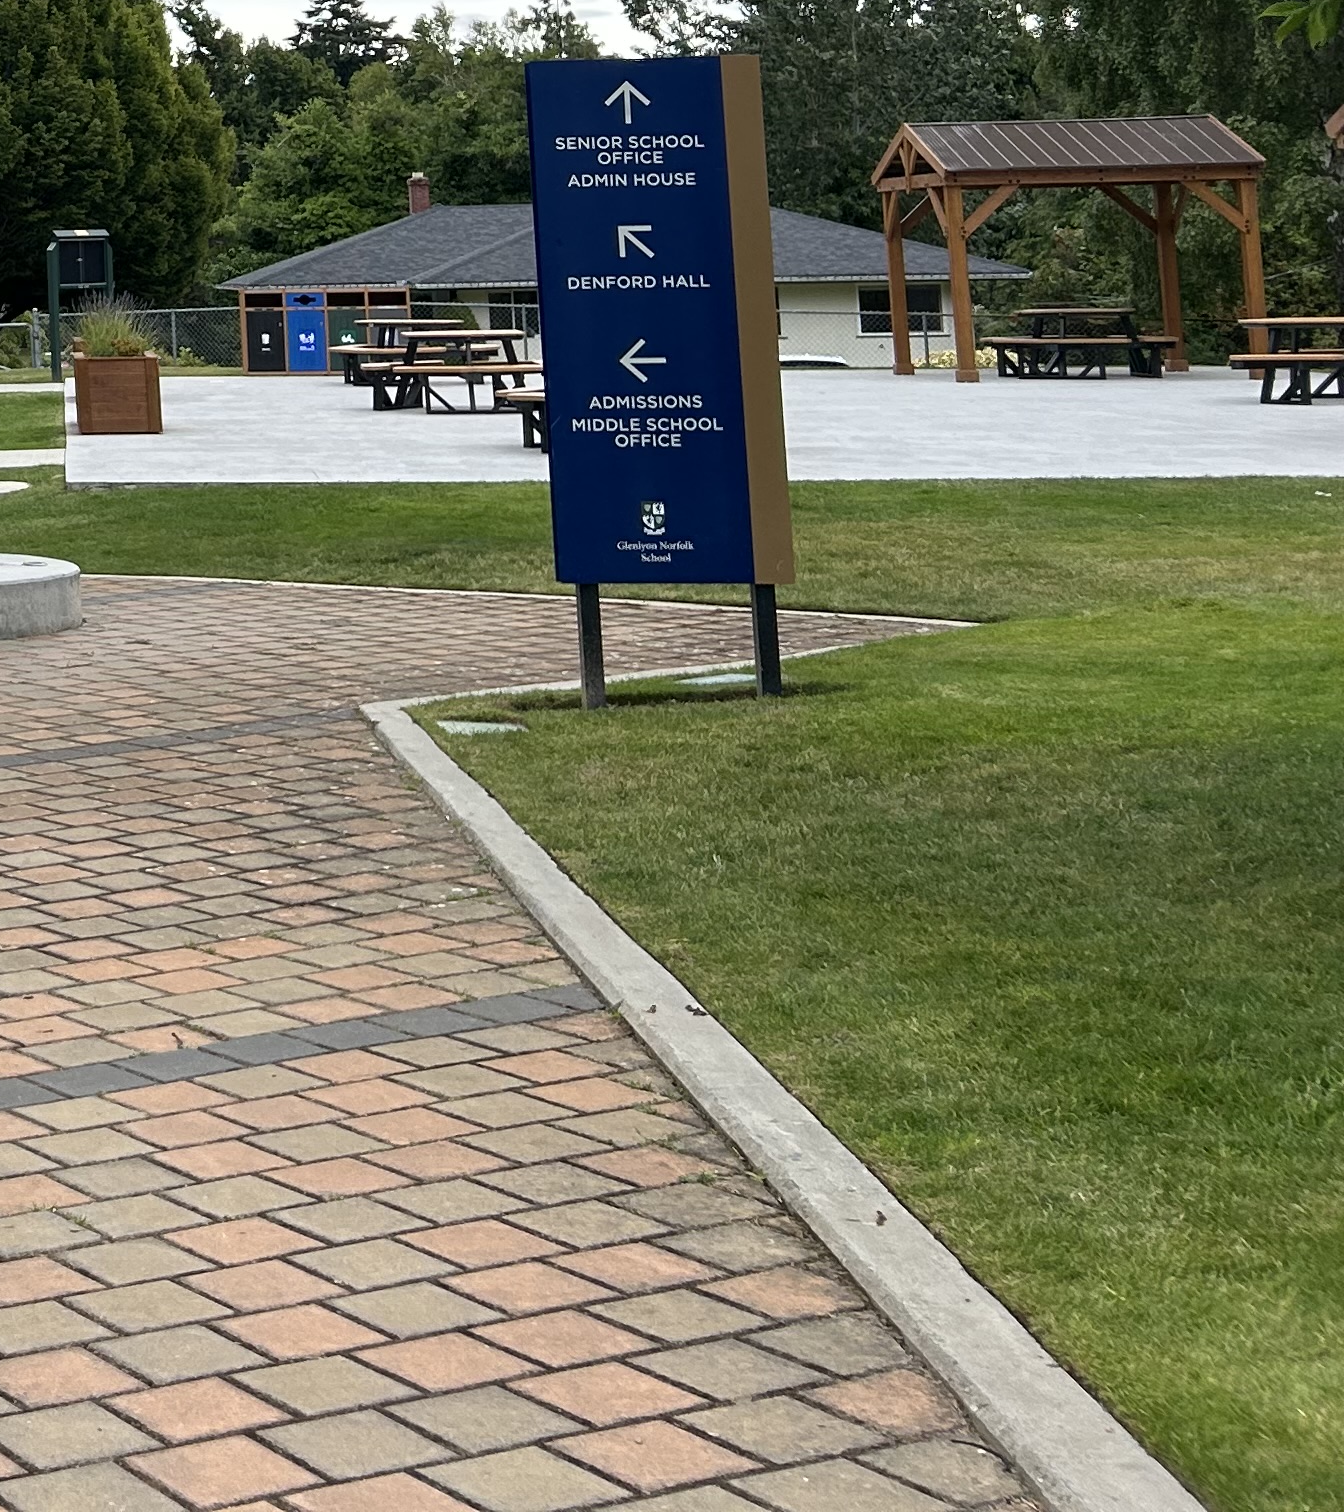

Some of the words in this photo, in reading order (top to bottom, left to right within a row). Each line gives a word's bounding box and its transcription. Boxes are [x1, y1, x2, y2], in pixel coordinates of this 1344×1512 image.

[555, 136, 623, 150] SENIOR
[628, 135, 705, 149] SCHOOL
[597, 151, 664, 165] OFFICE
[568, 174, 628, 187] ADMIN
[633, 172, 697, 186] HOUSE
[567, 275, 657, 290] DENFORD
[662, 274, 711, 288] HALL
[589, 395, 703, 409] ADMISSIONS
[572, 418, 641, 432] MIDDLE
[646, 417, 724, 431] SCHOOL
[615, 433, 682, 448] OFFICE
[659, 540, 694, 551] Norfolk
[640, 552, 672, 563] School
